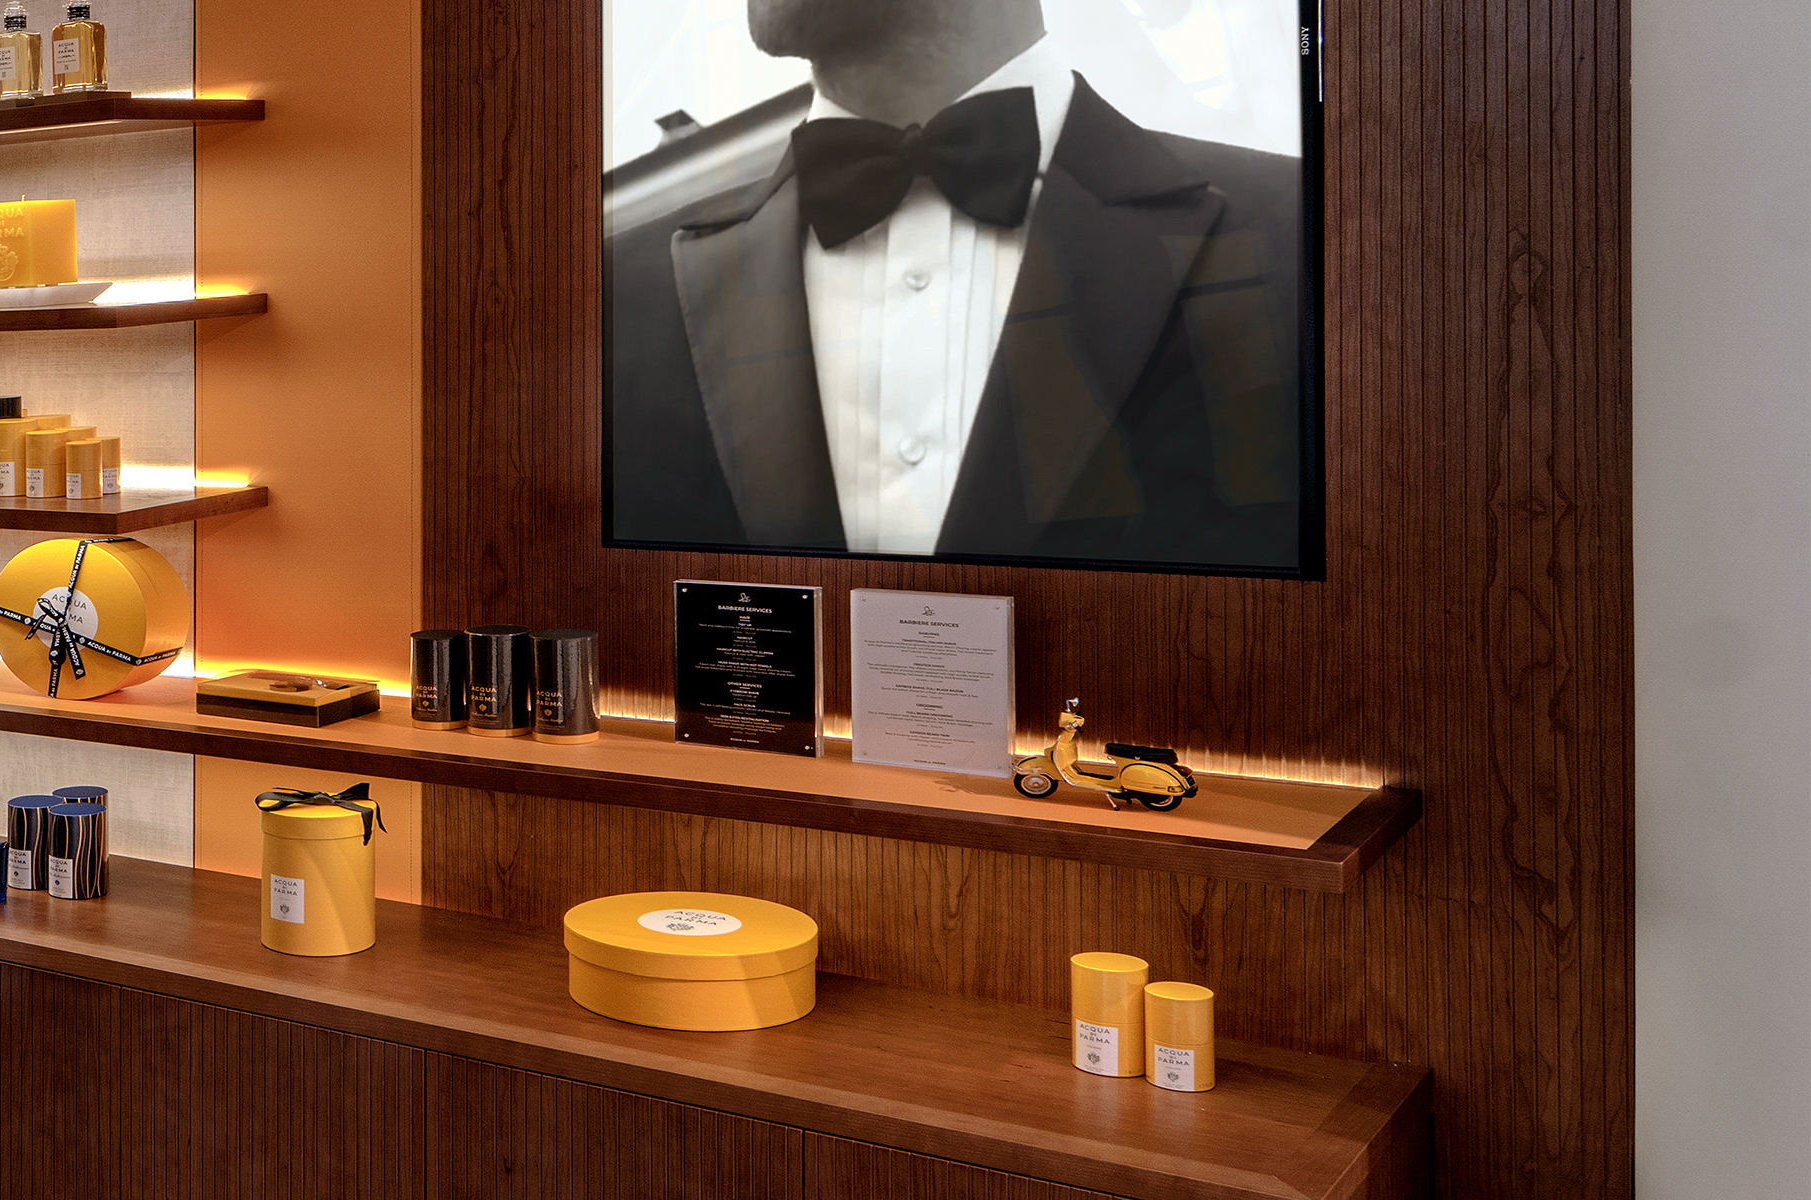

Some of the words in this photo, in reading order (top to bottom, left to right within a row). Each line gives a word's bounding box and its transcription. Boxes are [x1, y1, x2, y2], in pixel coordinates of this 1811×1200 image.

[1301, 26, 1310, 55] SONY
[52, 594, 87, 609] ACUA
[88, 641, 106, 652] ACQUA
[112, 651, 131, 662] PARMA
[536, 690, 562, 698] ACQUA
[274, 879, 297, 887] ACQUA
[274, 888, 297, 896] PARMA
[665, 915, 716, 925] PARMA
[674, 911, 726, 920] ACQUA
[1079, 1023, 1110, 1035] ACQUA
[1079, 1033, 1110, 1045] PARMA
[1158, 1047, 1190, 1057] ACQUA
[1157, 1056, 1190, 1066] PARMA
